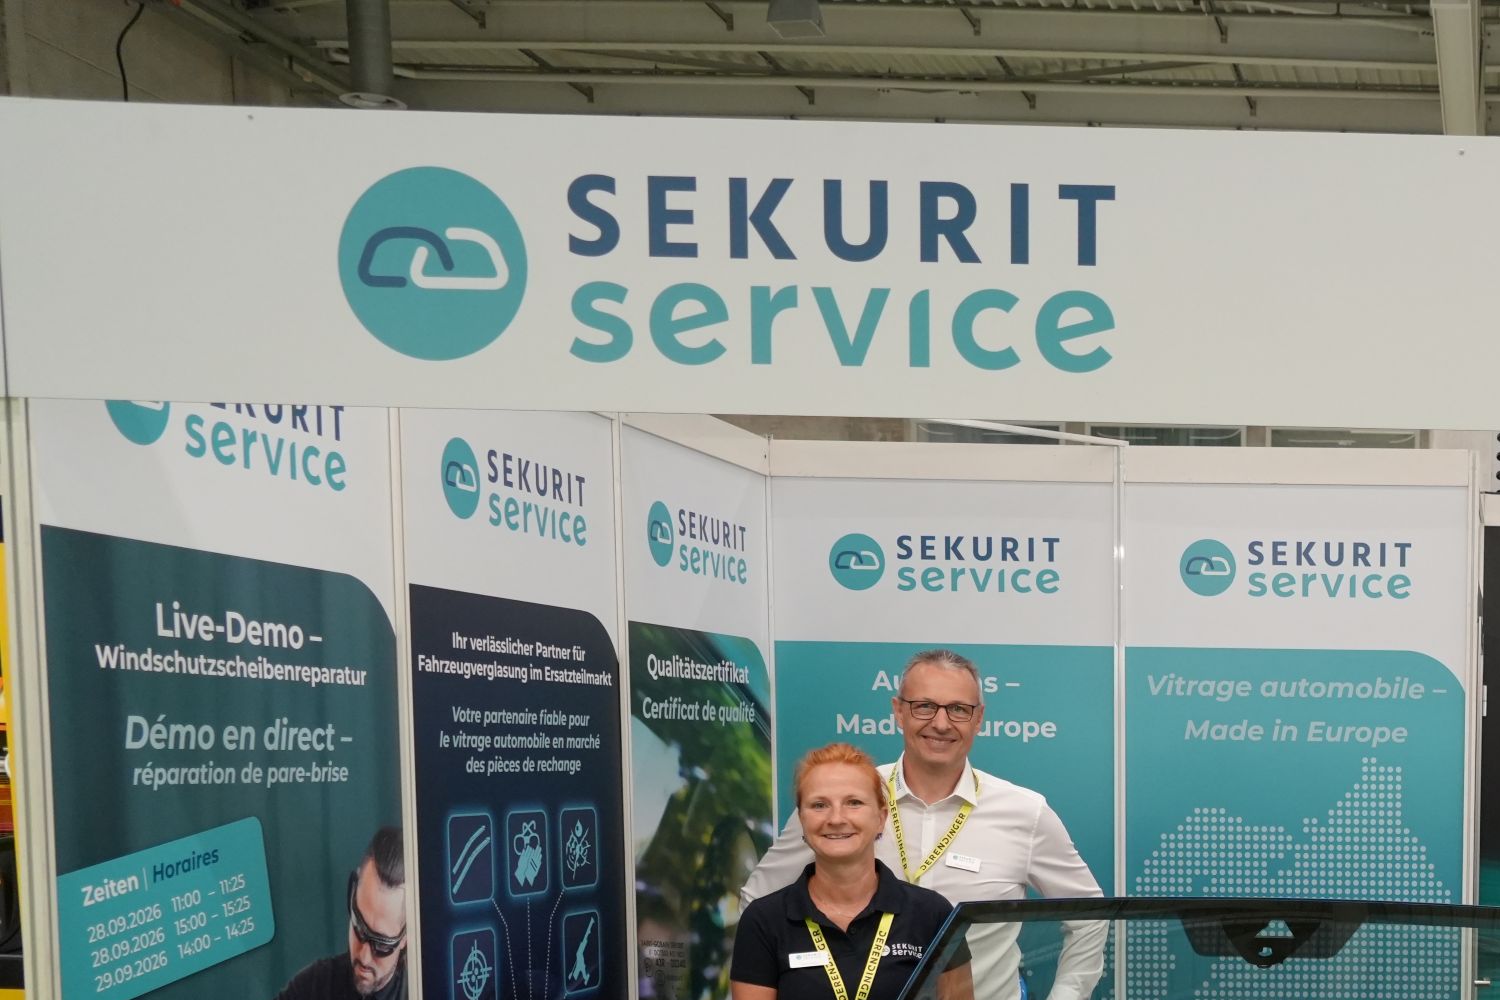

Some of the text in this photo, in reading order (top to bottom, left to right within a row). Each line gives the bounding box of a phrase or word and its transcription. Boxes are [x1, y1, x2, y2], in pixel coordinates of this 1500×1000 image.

[566, 173, 1116, 266] SEKURIT
[568, 280, 1116, 373] service
[184, 413, 347, 492] service
[487, 449, 586, 507] SEKURIT
[488, 492, 587, 547] service
[678, 508, 747, 552] SEKURIT
[679, 543, 748, 585] service
[896, 534, 1060, 563] SEKURIT
[1247, 540, 1412, 568] SEKURIT
[896, 565, 1060, 594] service
[1247, 571, 1412, 600] service
[155, 601, 304, 650] Live-Demo
[452, 631, 586, 662] Ihr verlässlicher Partner für
[95, 644, 367, 688] Windschutzscheibenreparatur
[418, 654, 612, 687] Fahrzeugverglasung im Ersatzteilmarkt
[646, 653, 750, 686] Qualitätszertifikat
[1147, 674, 1425, 702] Vitrage automobile
[452, 705, 590, 731] Votre partenaire fiable pour
[642, 696, 756, 728] Certificat de qualité
[125, 714, 335, 752] Démo en direct
[439, 730, 600, 753] le vitrage automobile en marché
[977, 719, 1058, 743] urope
[1184, 718, 1409, 748] Made in Europe
[132, 760, 348, 791] réparation de pare-brise
[466, 755, 582, 778] des pièces de rechange
[80, 847, 220, 907] Zeiten Horaires
[87, 873, 246, 944] 28.09.2026 11:00 11:25
[91, 895, 251, 969] 28.09.2026 15:00 15:25
[94, 916, 256, 993] 29.09.2026 14:00 14:25
